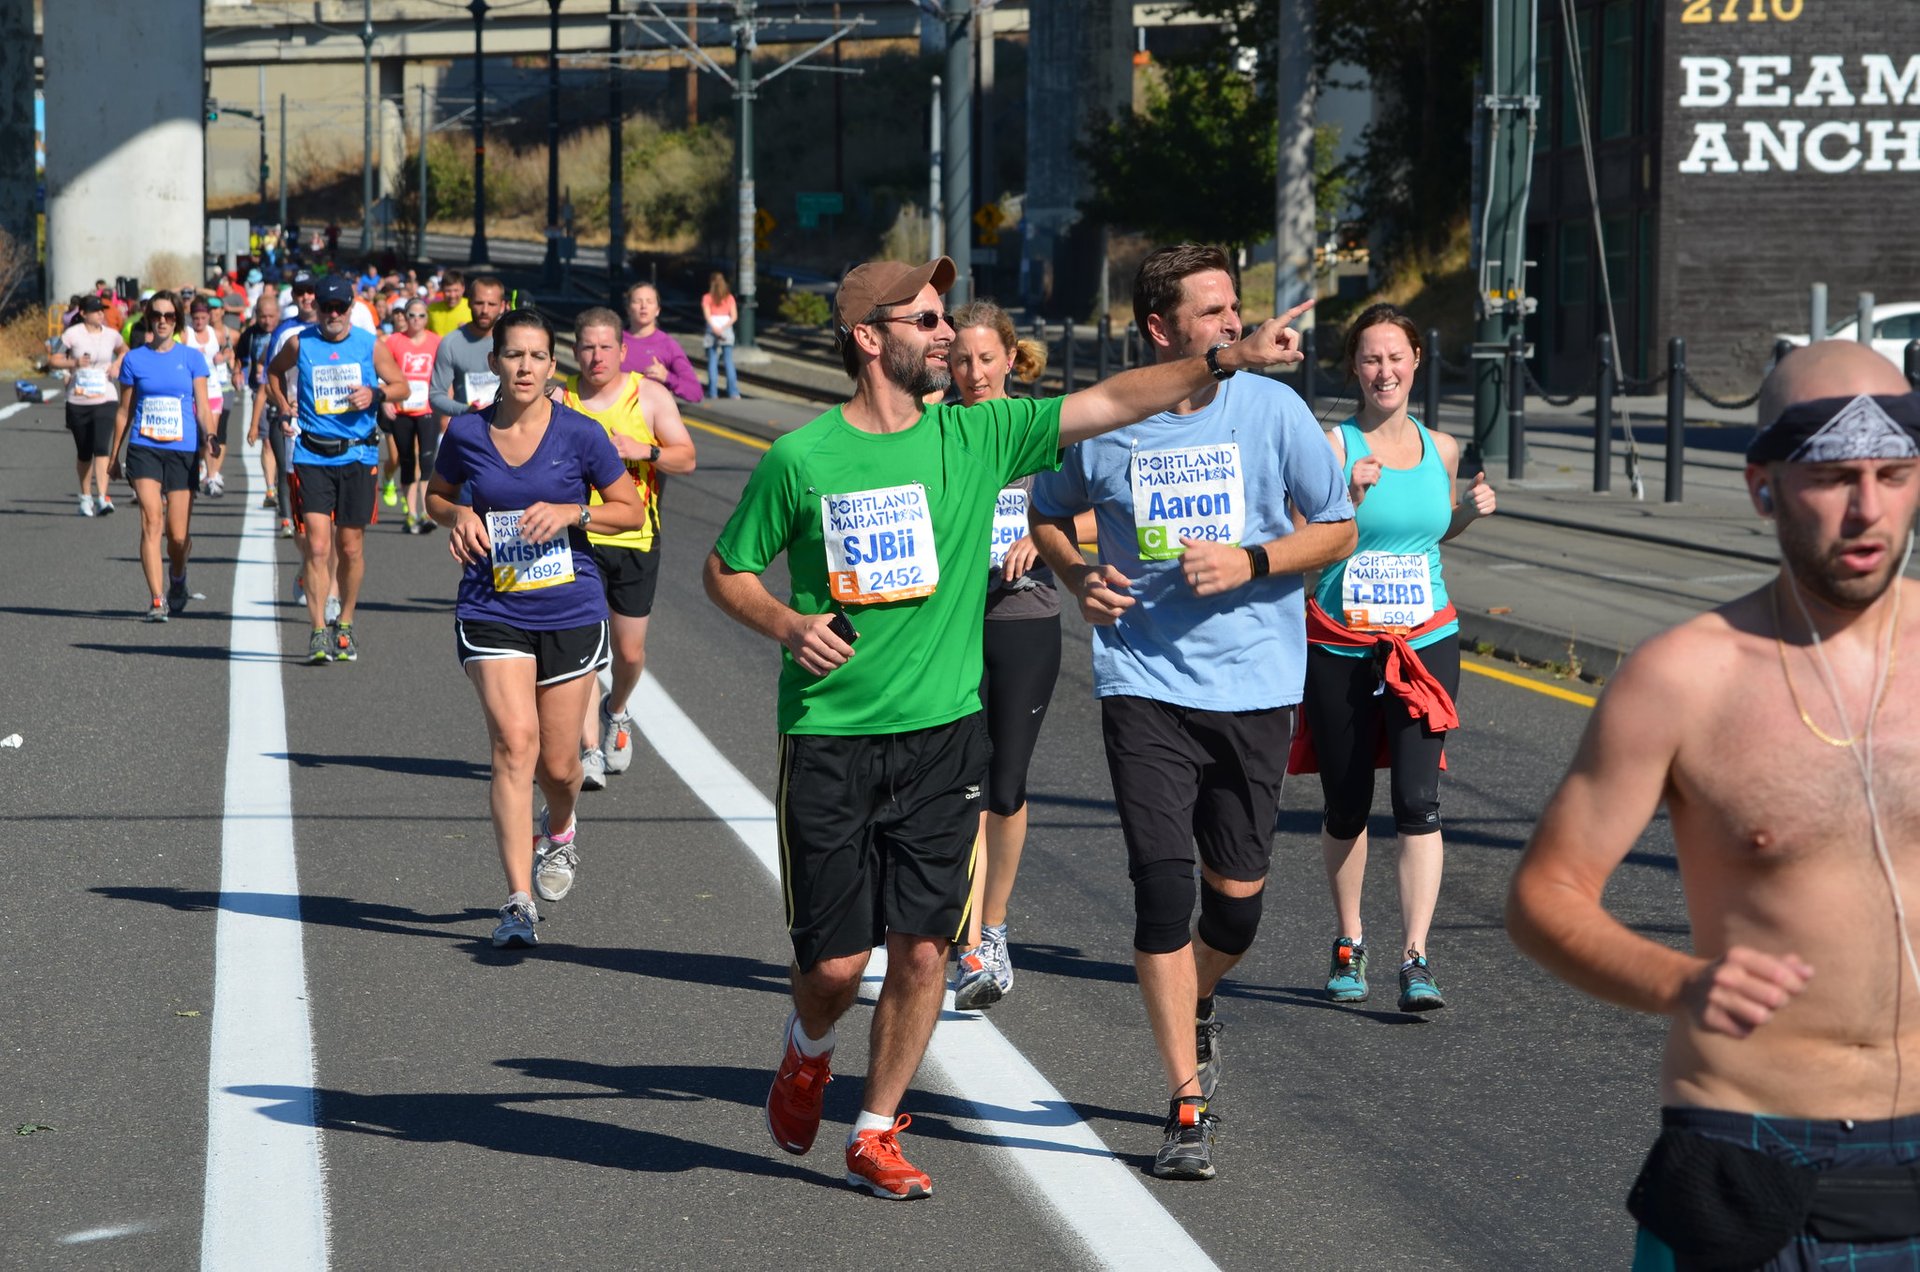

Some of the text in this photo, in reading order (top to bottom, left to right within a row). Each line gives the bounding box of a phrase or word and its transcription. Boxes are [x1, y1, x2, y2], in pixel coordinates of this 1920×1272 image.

[1679, 54, 1920, 107] BEAM
[1678, 120, 1920, 173] ANCH
[145, 414, 179, 427] Mosey
[1137, 451, 1232, 471] PORTLAND
[829, 492, 920, 514] PORTLAND
[1148, 492, 1231, 521] Aaron
[843, 528, 915, 566] SJBii
[1144, 529, 1161, 548] C
[494, 537, 566, 563] Kristen
[1354, 555, 1422, 567] ORTLAND
[524, 562, 562, 580] 1892
[838, 566, 924, 594] E 2452
[1350, 583, 1425, 605] T-BIRD
[1383, 611, 1416, 625] 594
